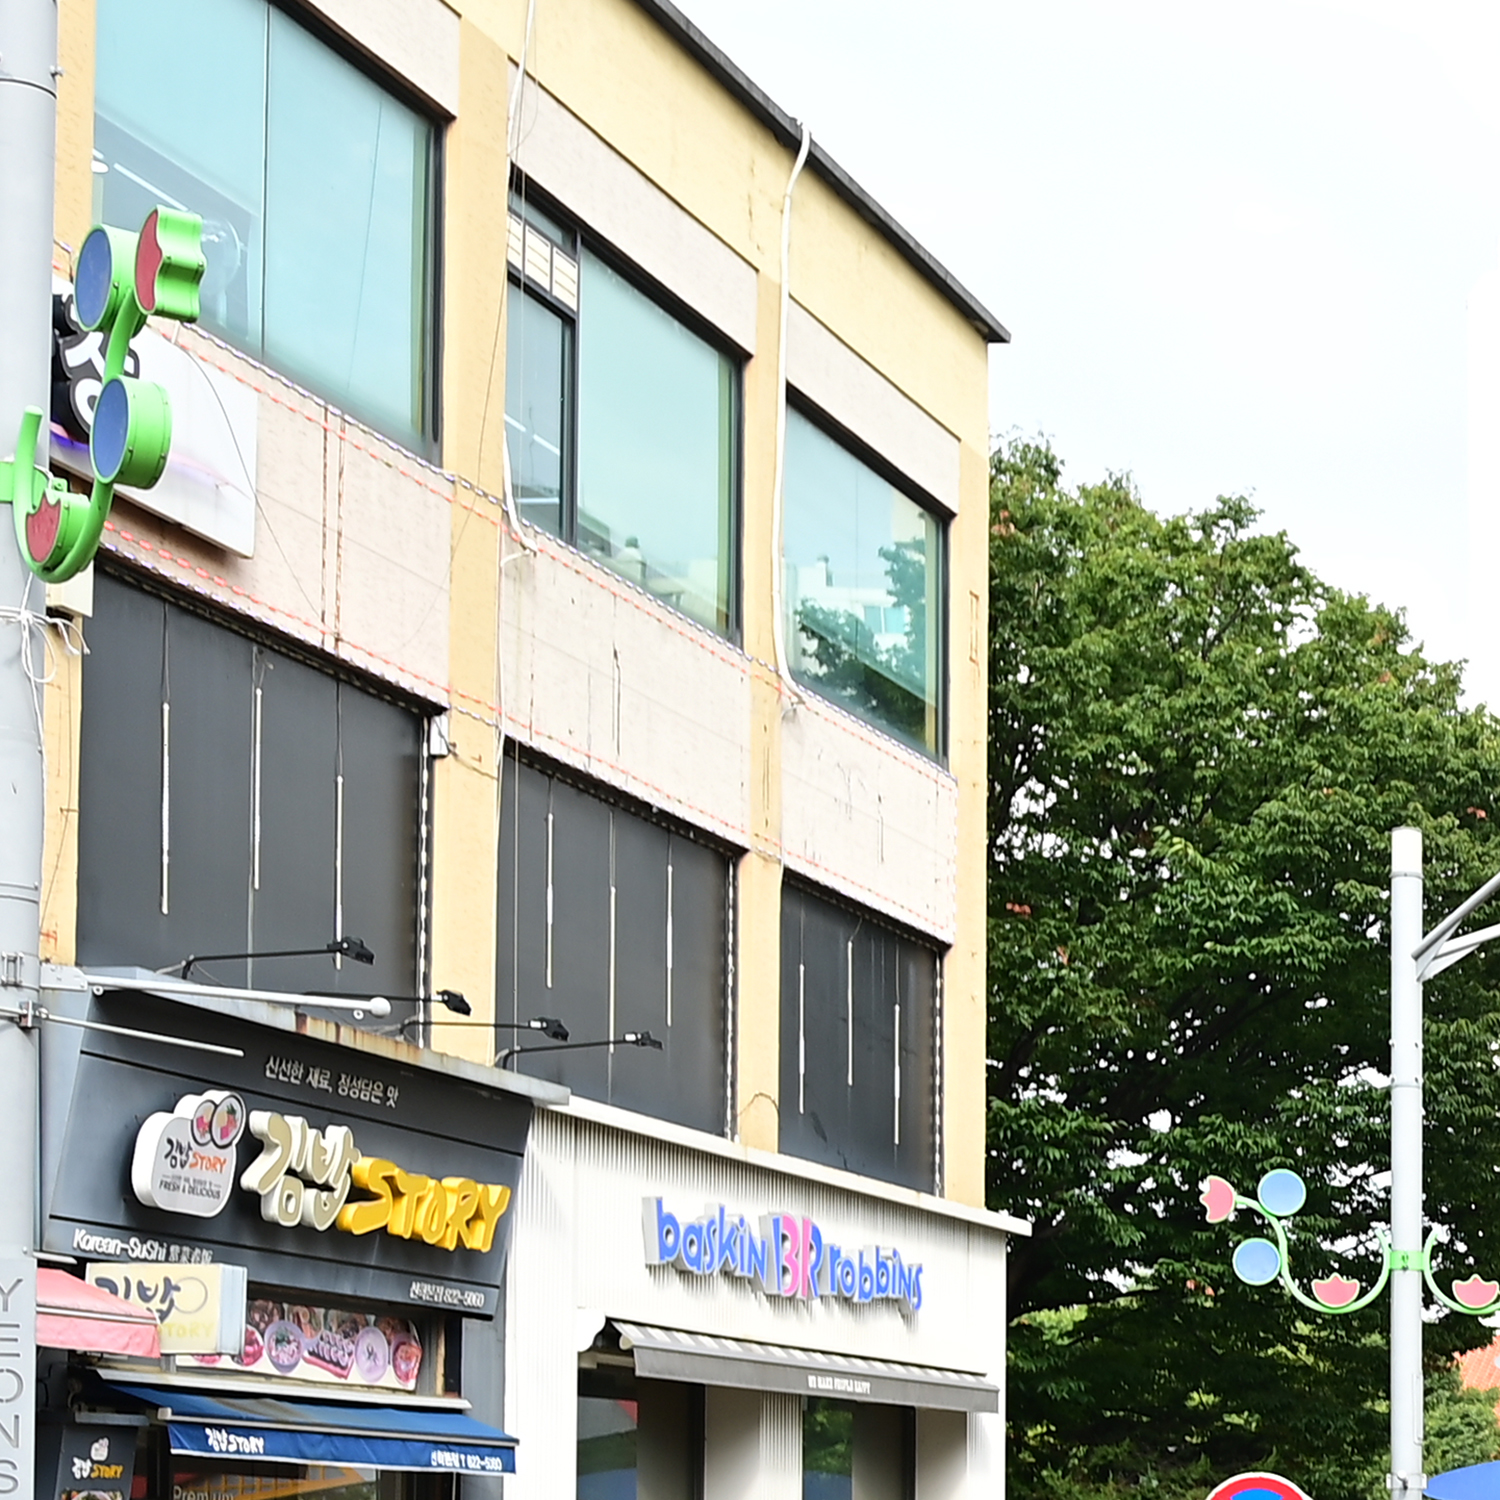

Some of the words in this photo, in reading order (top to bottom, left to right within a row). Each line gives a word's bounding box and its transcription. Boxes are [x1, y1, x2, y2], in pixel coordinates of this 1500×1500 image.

[265, 1055, 304, 1085] 신선한
[305, 1067, 333, 1095] 재료,
[337, 1073, 384, 1103] 정성담은
[386, 1086, 398, 1107] 맛
